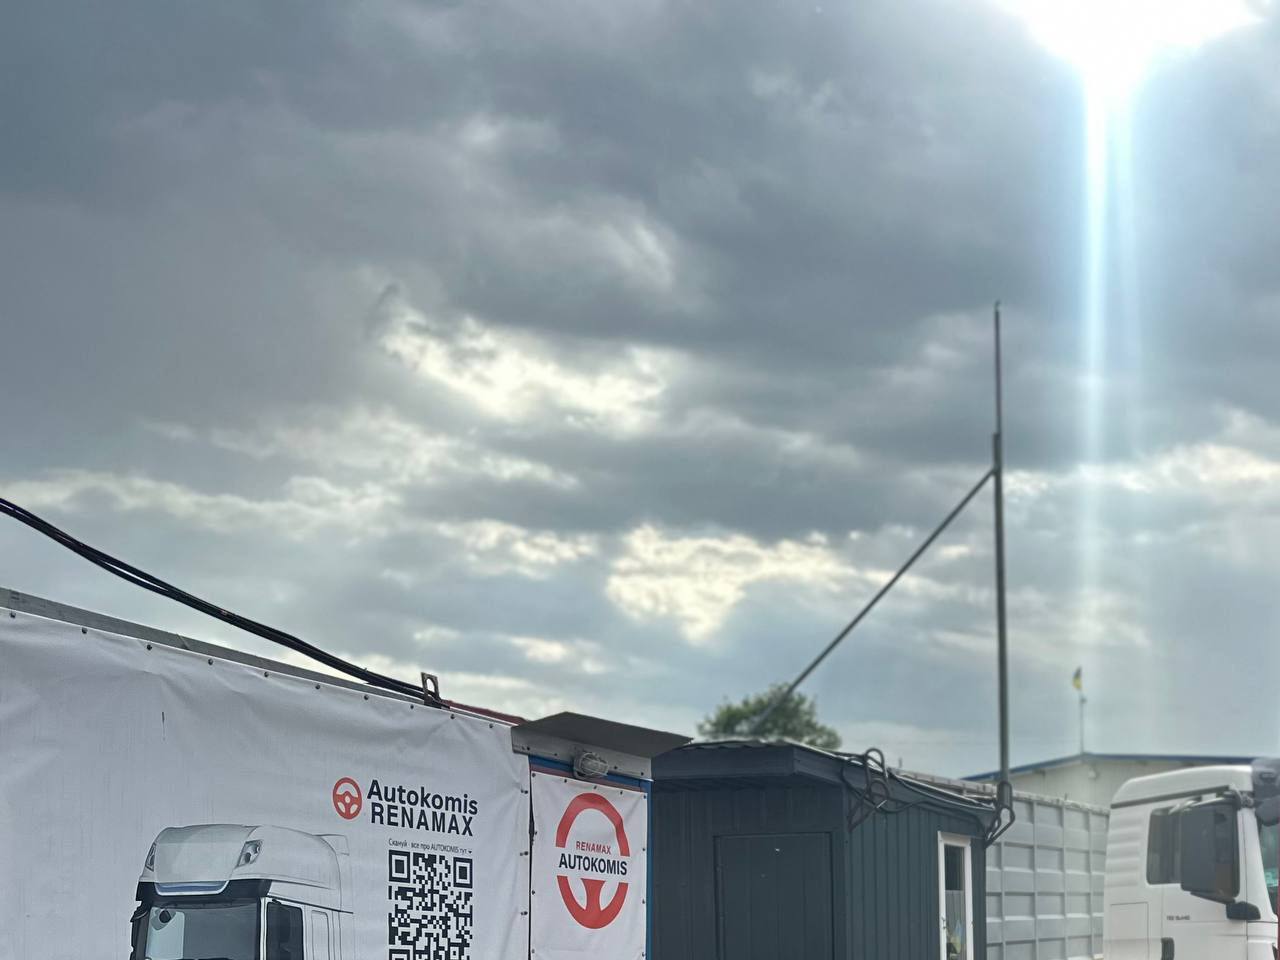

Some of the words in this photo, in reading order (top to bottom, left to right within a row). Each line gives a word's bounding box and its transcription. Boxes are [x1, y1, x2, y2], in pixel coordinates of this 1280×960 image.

[367, 779, 478, 815] Autokomis
[371, 802, 473, 837] RENAMAX
[575, 841, 612, 855] RENAMAX
[558, 853, 628, 876] AUTOKOMIS
